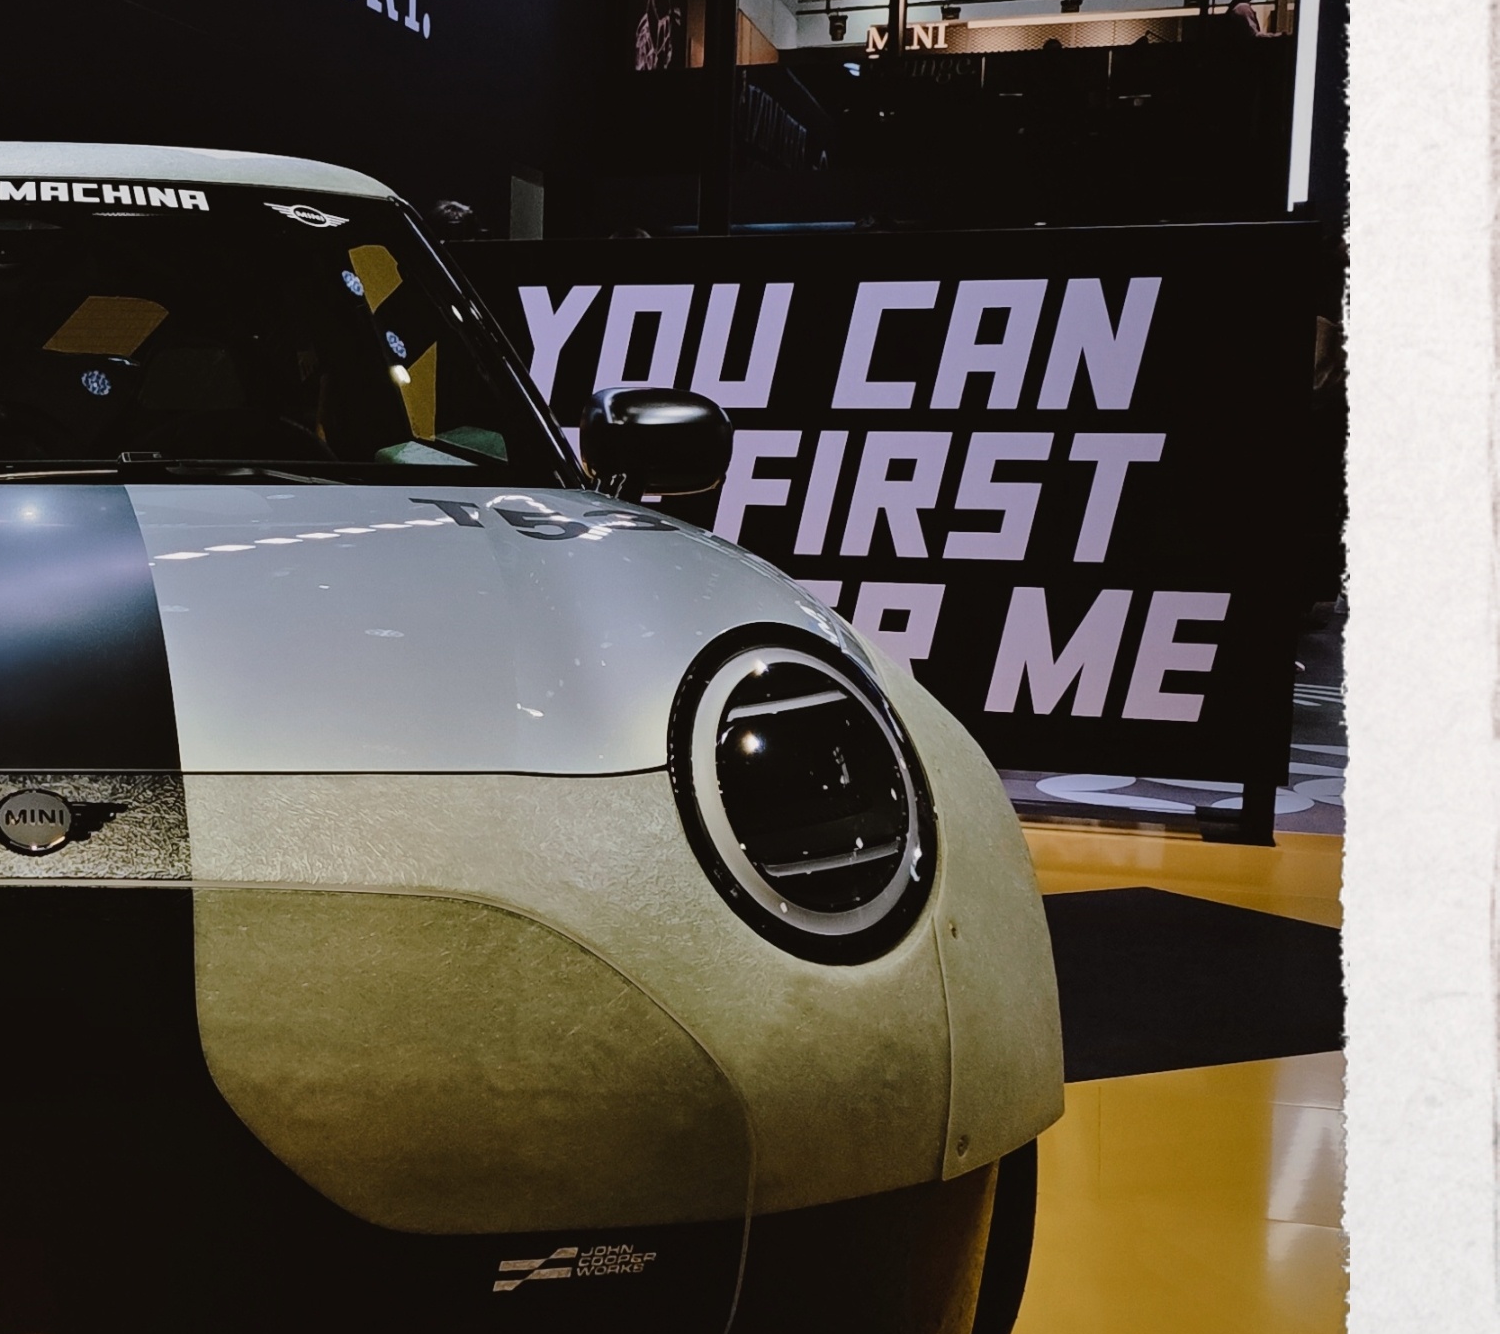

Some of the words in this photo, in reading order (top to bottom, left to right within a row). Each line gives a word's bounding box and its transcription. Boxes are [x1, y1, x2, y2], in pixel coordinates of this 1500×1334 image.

[865, 23, 949, 52] MNI
[0, 180, 210, 211] MACHINA
[518, 282, 794, 409] YOU
[831, 276, 1163, 411] CAN
[712, 430, 1167, 563] FIRST
[794, 579, 946, 679] R
[983, 586, 1232, 723] ME
[5, 809, 64, 826] MINI
[578, 1252, 657, 1267] COOPER
[581, 1244, 634, 1256] JOHN
[576, 1263, 645, 1277] WORKS
